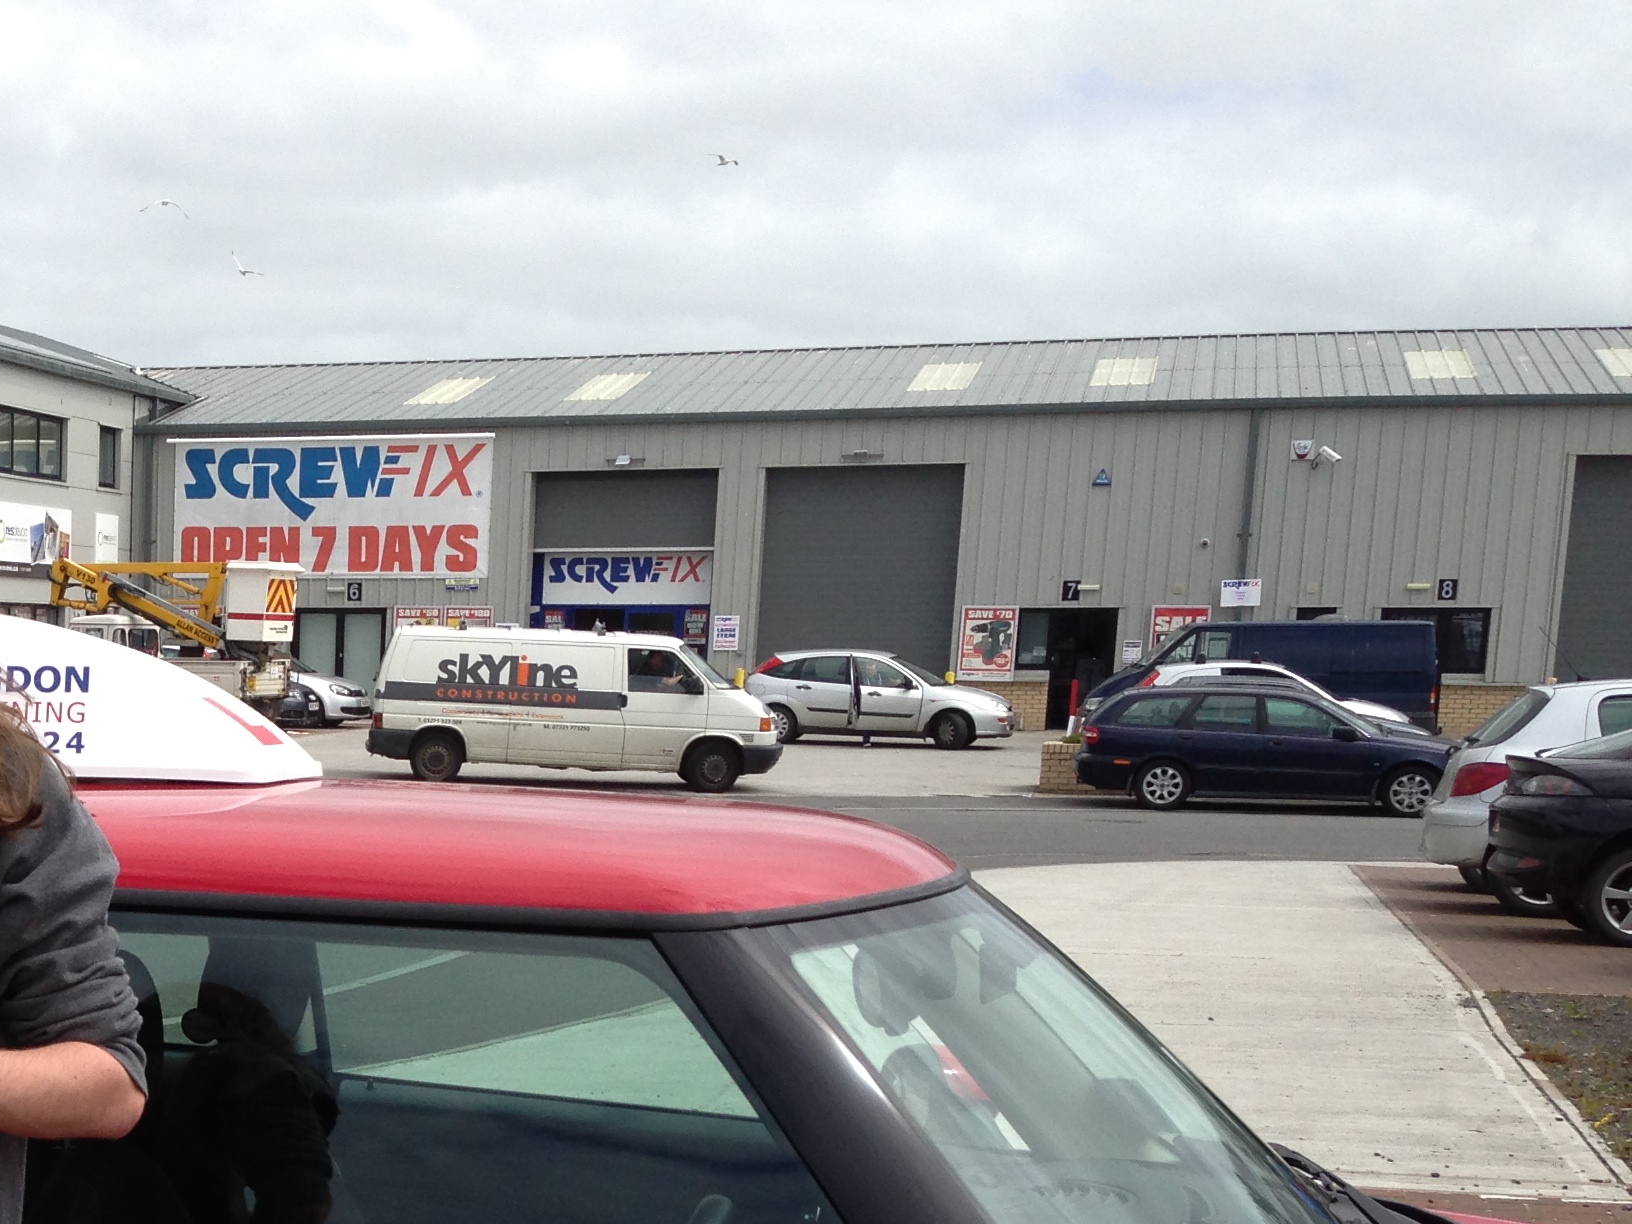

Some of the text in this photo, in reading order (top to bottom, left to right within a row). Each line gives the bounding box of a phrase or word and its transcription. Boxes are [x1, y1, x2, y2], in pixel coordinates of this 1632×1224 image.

[183, 443, 487, 521] SCREWFIX
[181, 524, 478, 572] OPEN 7 DAYS
[549, 556, 708, 594] SCREWFIX
[350, 584, 359, 599] 6
[1066, 583, 1076, 599] 7
[1442, 581, 1453, 598] 8
[436, 688, 576, 704] CONSTRUCTION
[44, 731, 85, 754] 24
